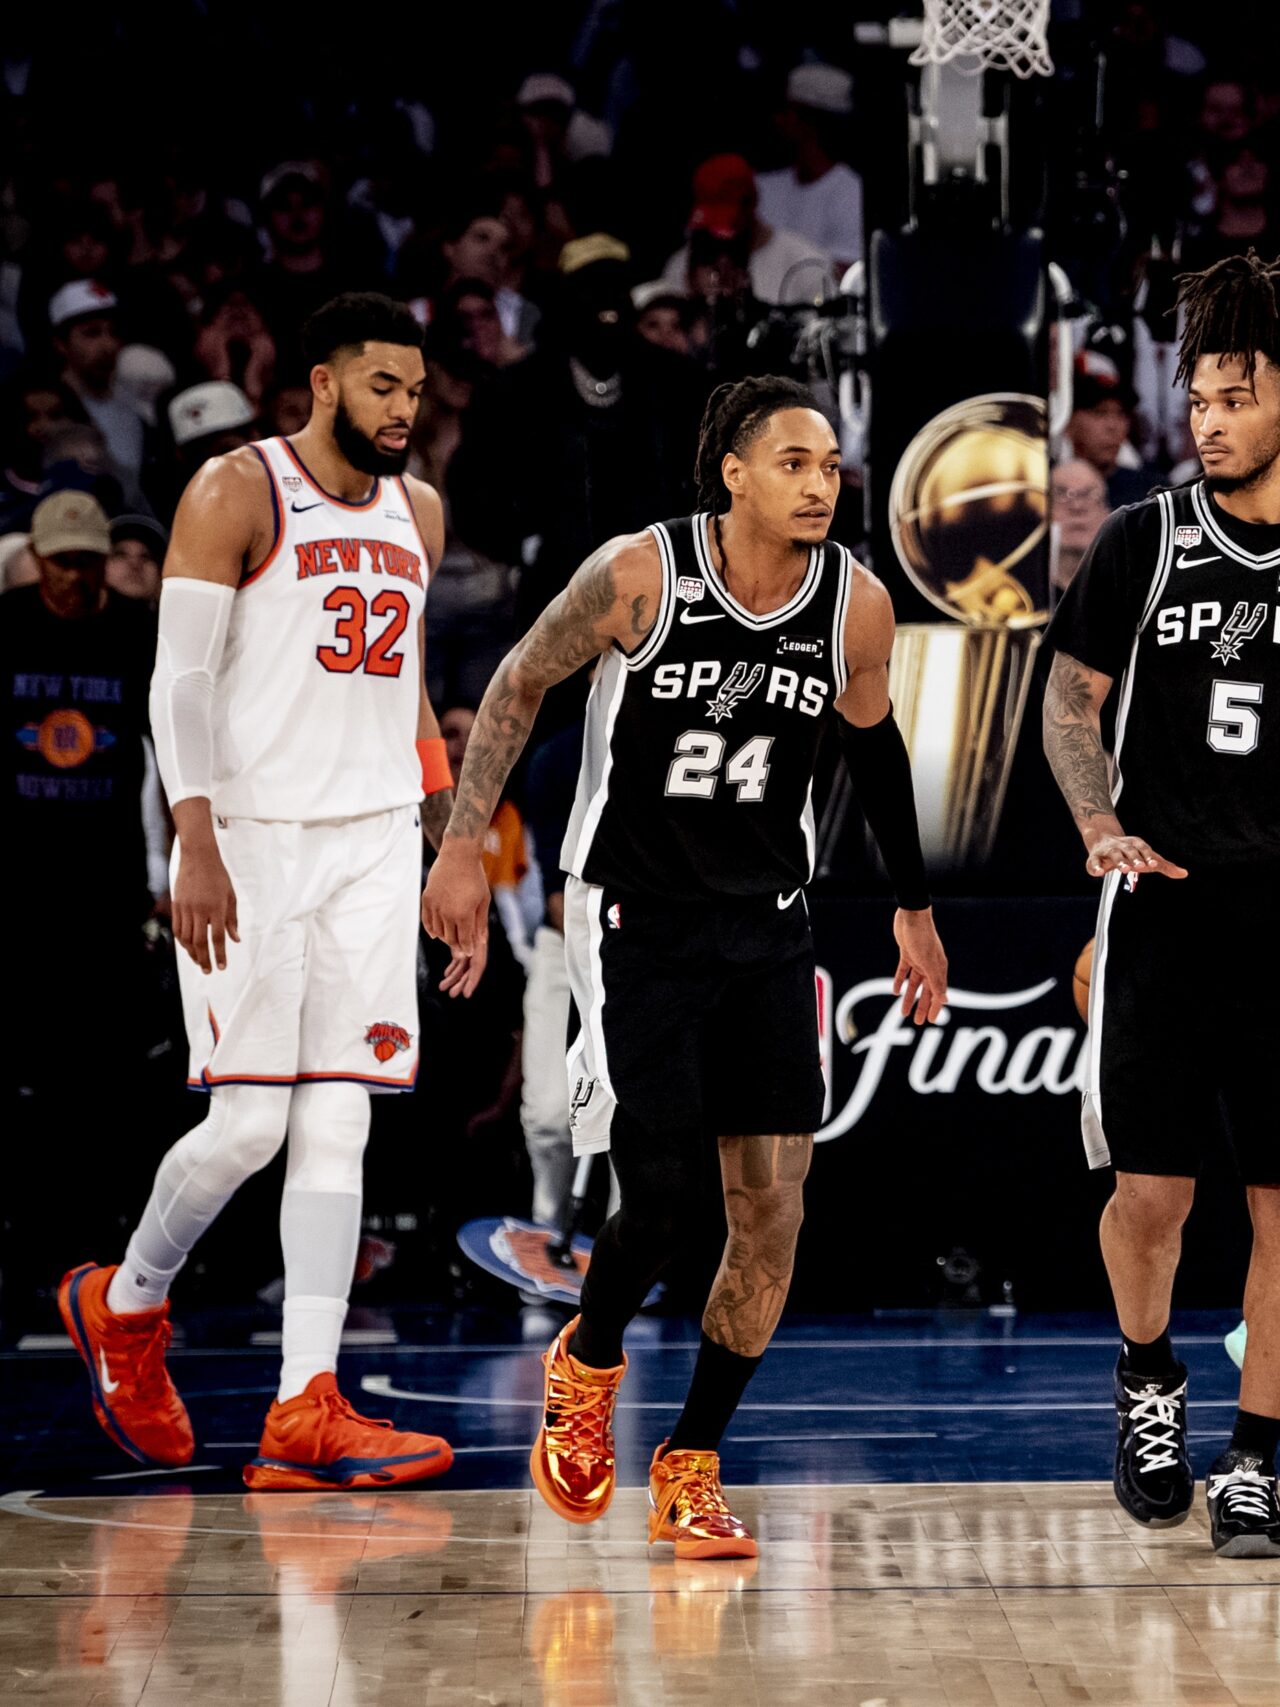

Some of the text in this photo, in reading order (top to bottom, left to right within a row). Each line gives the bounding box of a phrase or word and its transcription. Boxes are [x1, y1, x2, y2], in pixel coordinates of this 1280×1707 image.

[294, 538, 425, 592] NEW YORK
[317, 586, 410, 678] 32
[782, 640, 818, 653] LEDGER
[651, 660, 829, 724] SPURS
[1206, 678, 1264, 756] 5
[664, 729, 776, 803] 24
[814, 976, 1092, 1144] Fina
